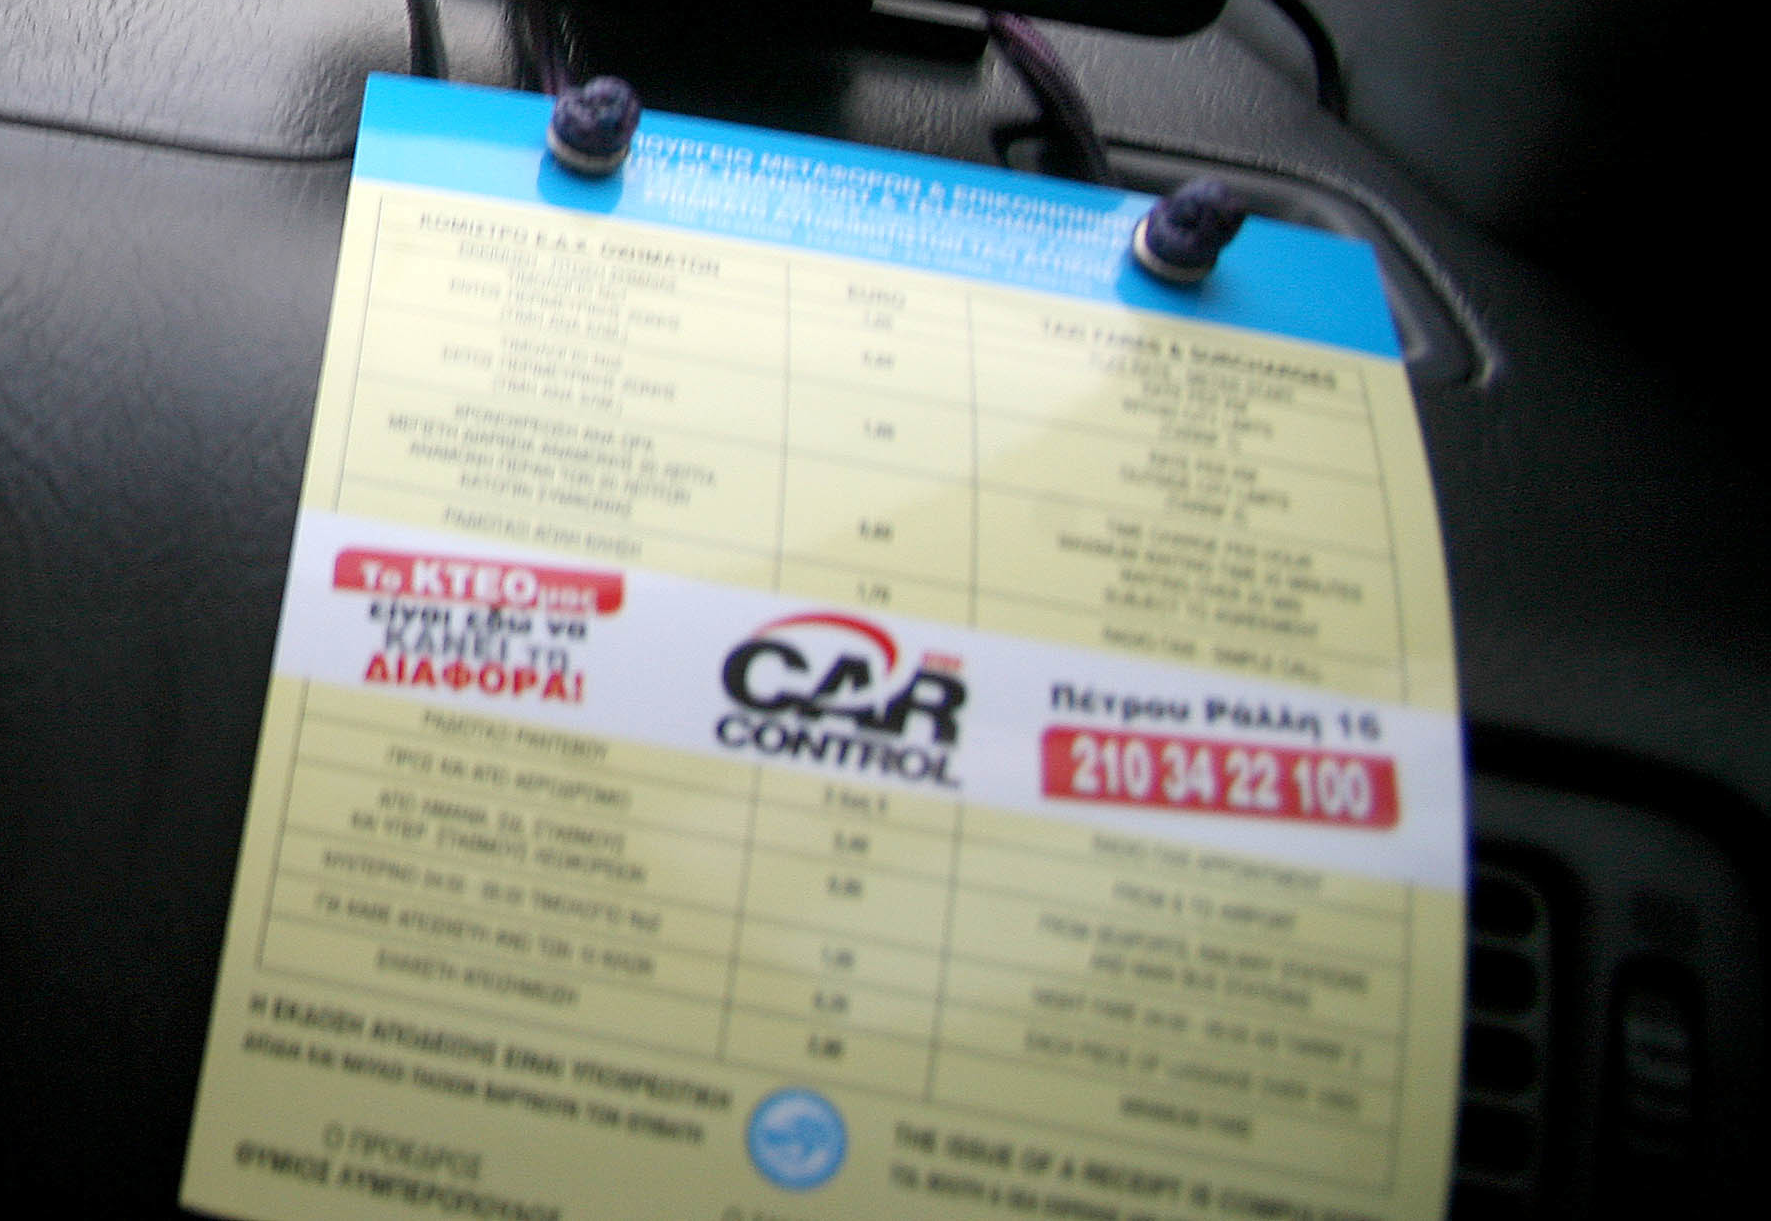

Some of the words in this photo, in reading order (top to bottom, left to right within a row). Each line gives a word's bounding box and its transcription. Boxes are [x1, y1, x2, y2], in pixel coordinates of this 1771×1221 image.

[364, 652, 584, 704] ΔΙΑΦΟΡΑ!
[722, 637, 969, 746] CAR
[1050, 682, 1190, 724] Πέτρου
[715, 712, 962, 788] CONTROL
[1069, 733, 1155, 800] 210
[1159, 742, 1218, 804] 34
[1226, 749, 1281, 813] 22
[1292, 757, 1374, 822] 100
